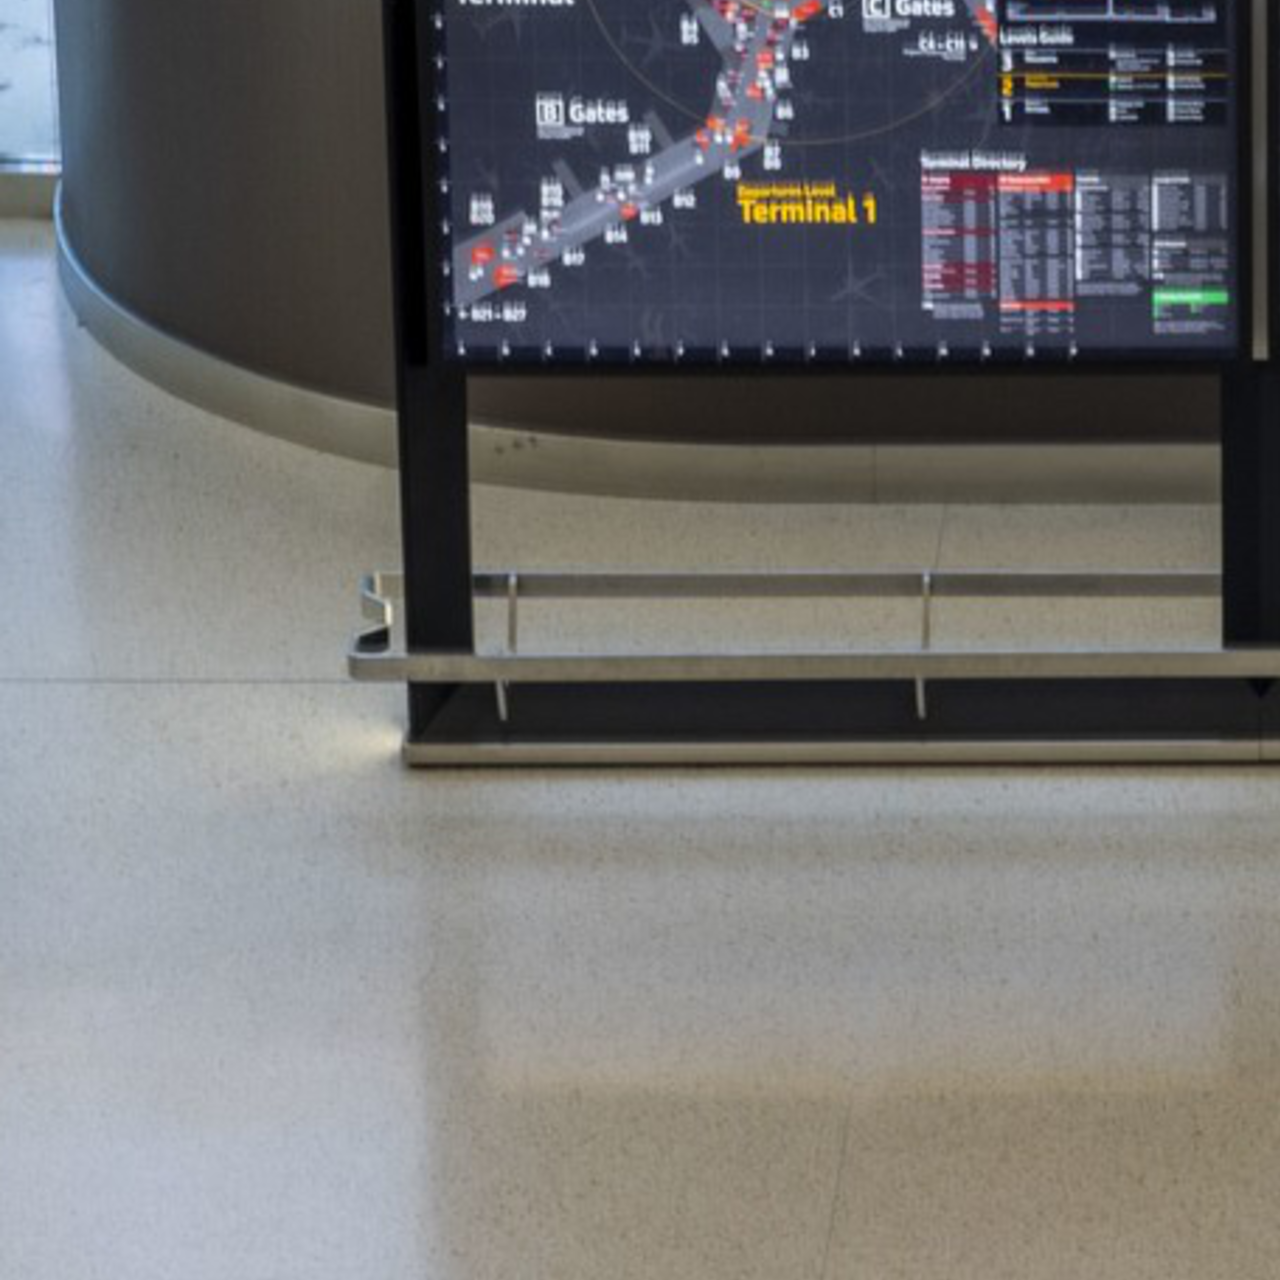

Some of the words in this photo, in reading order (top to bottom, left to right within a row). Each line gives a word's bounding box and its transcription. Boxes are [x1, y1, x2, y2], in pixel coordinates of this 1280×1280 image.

[570, 99, 629, 124] Gates
[737, 194, 858, 224] Terminal
[862, 191, 877, 224] 1
